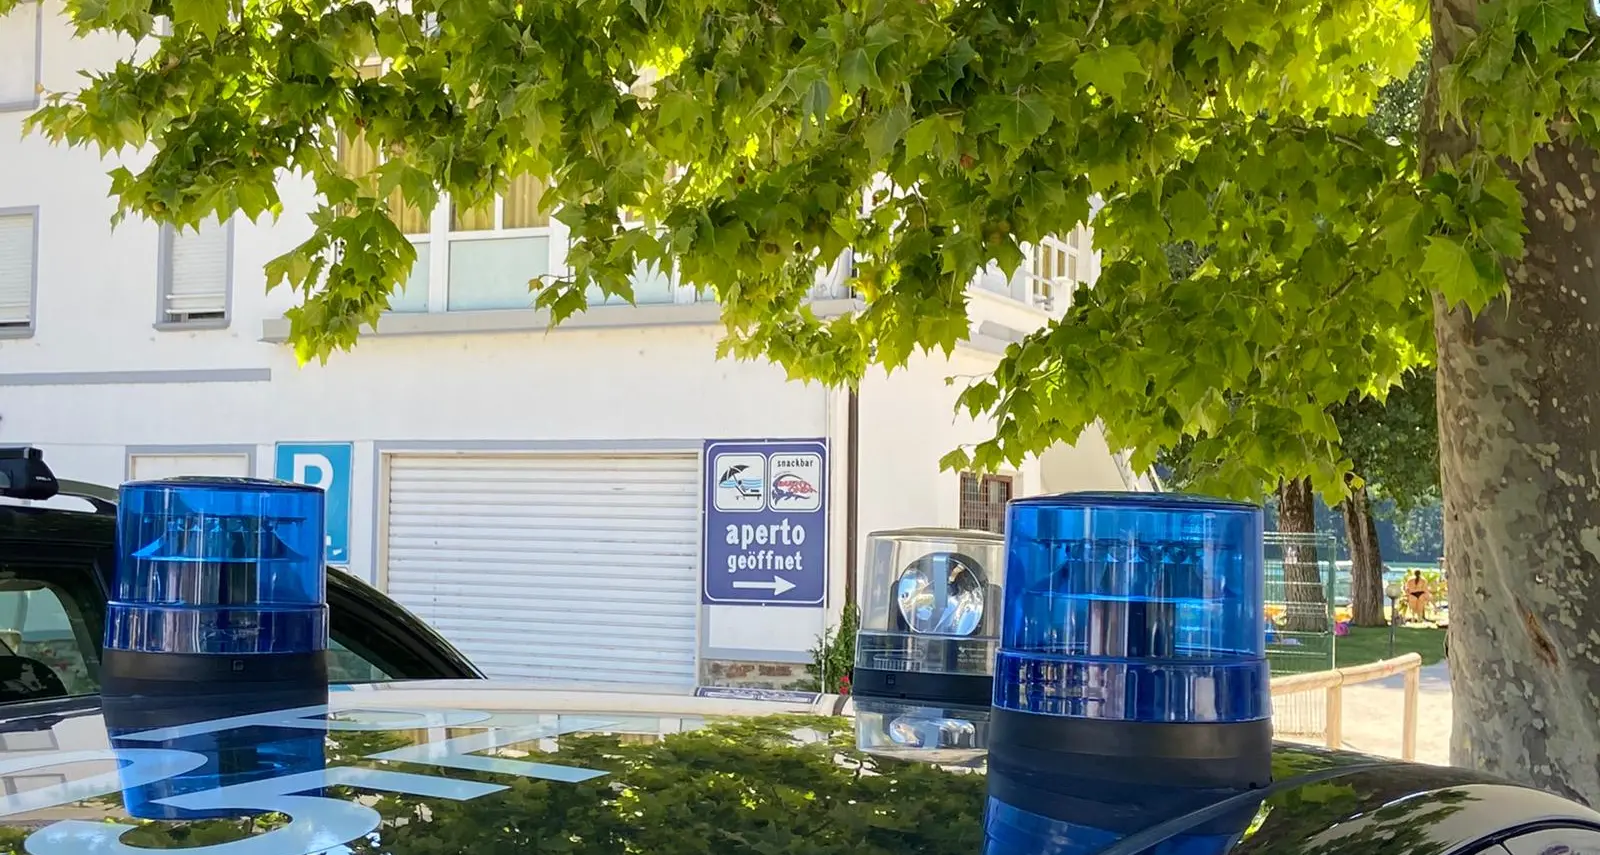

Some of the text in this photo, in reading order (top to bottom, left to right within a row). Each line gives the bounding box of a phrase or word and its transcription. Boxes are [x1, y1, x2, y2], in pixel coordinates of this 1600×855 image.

[777, 459, 814, 468] snackbar
[726, 518, 806, 550] aperto
[727, 550, 803, 573] geöffnet
